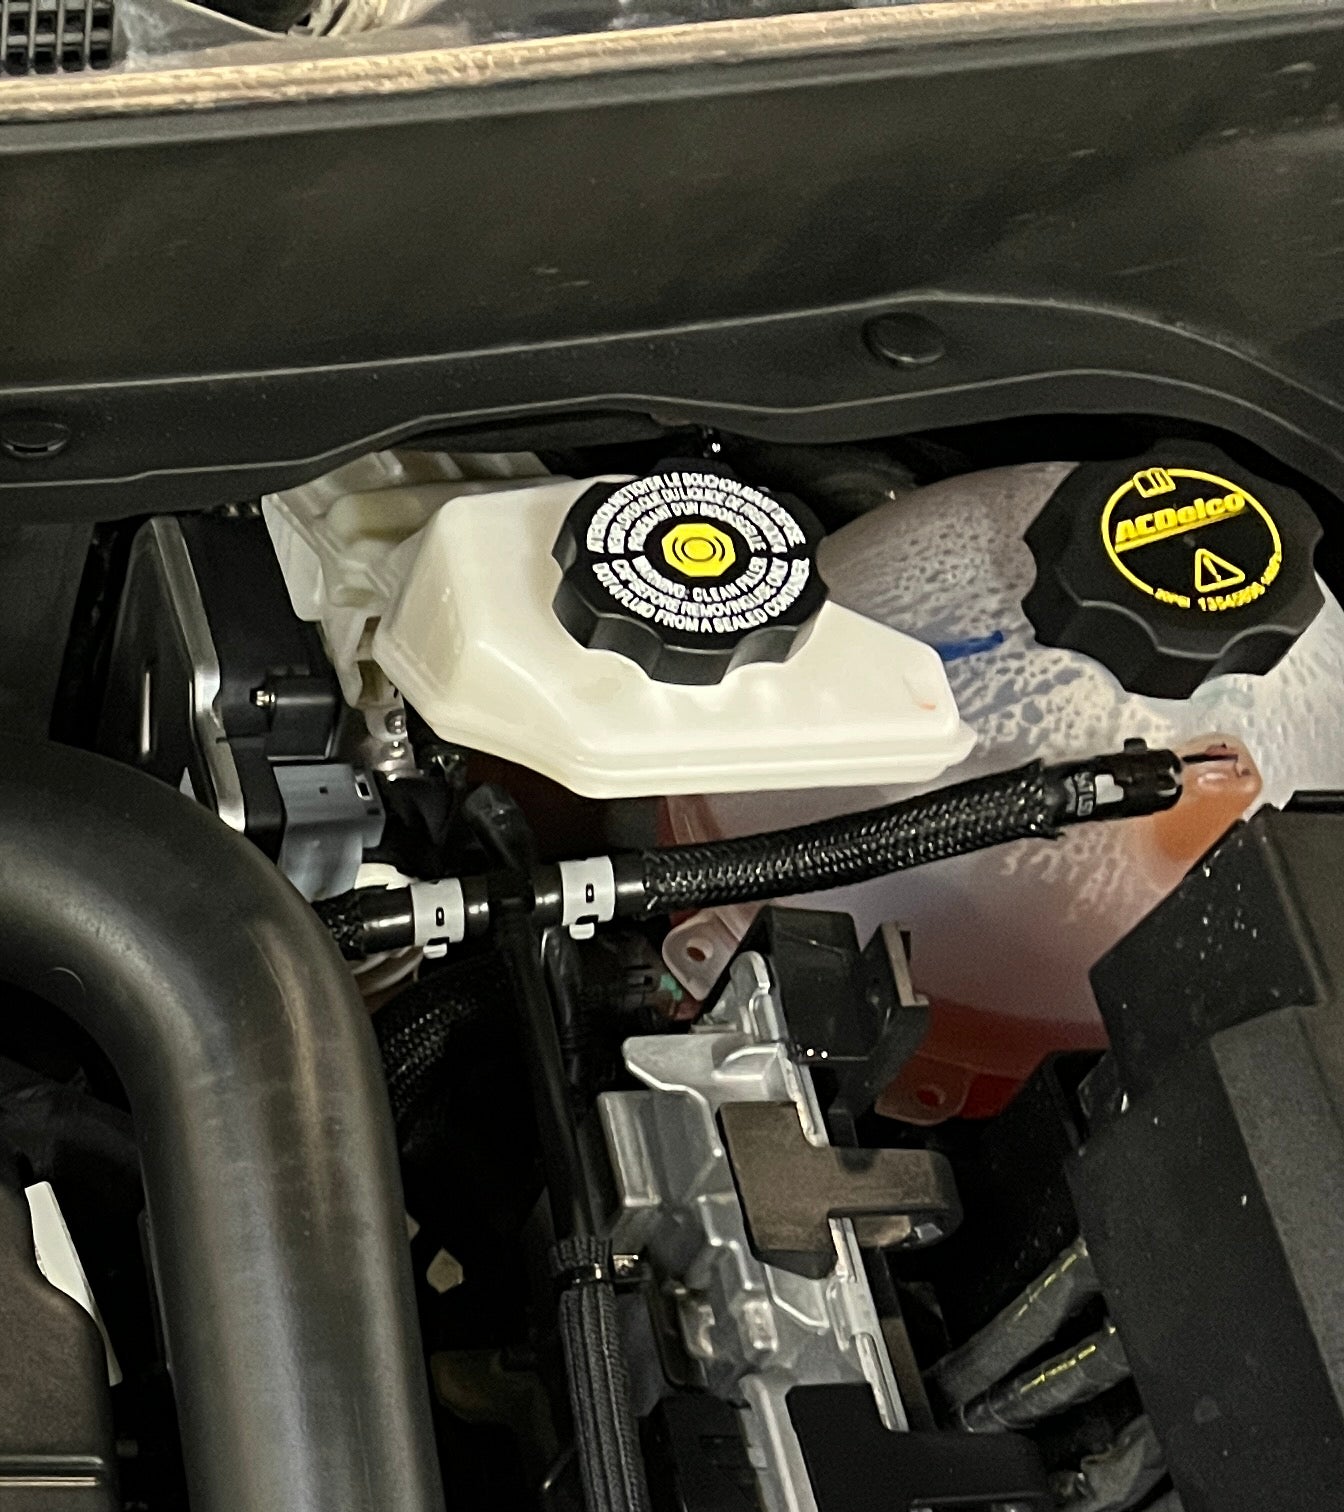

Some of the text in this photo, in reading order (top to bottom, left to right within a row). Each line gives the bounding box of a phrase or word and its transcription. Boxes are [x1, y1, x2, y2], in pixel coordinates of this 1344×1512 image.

[1115, 493, 1246, 543] ACDelco
[690, 581, 744, 602] CLEAN
[651, 608, 699, 632] FROM
[700, 617, 713, 633] A
